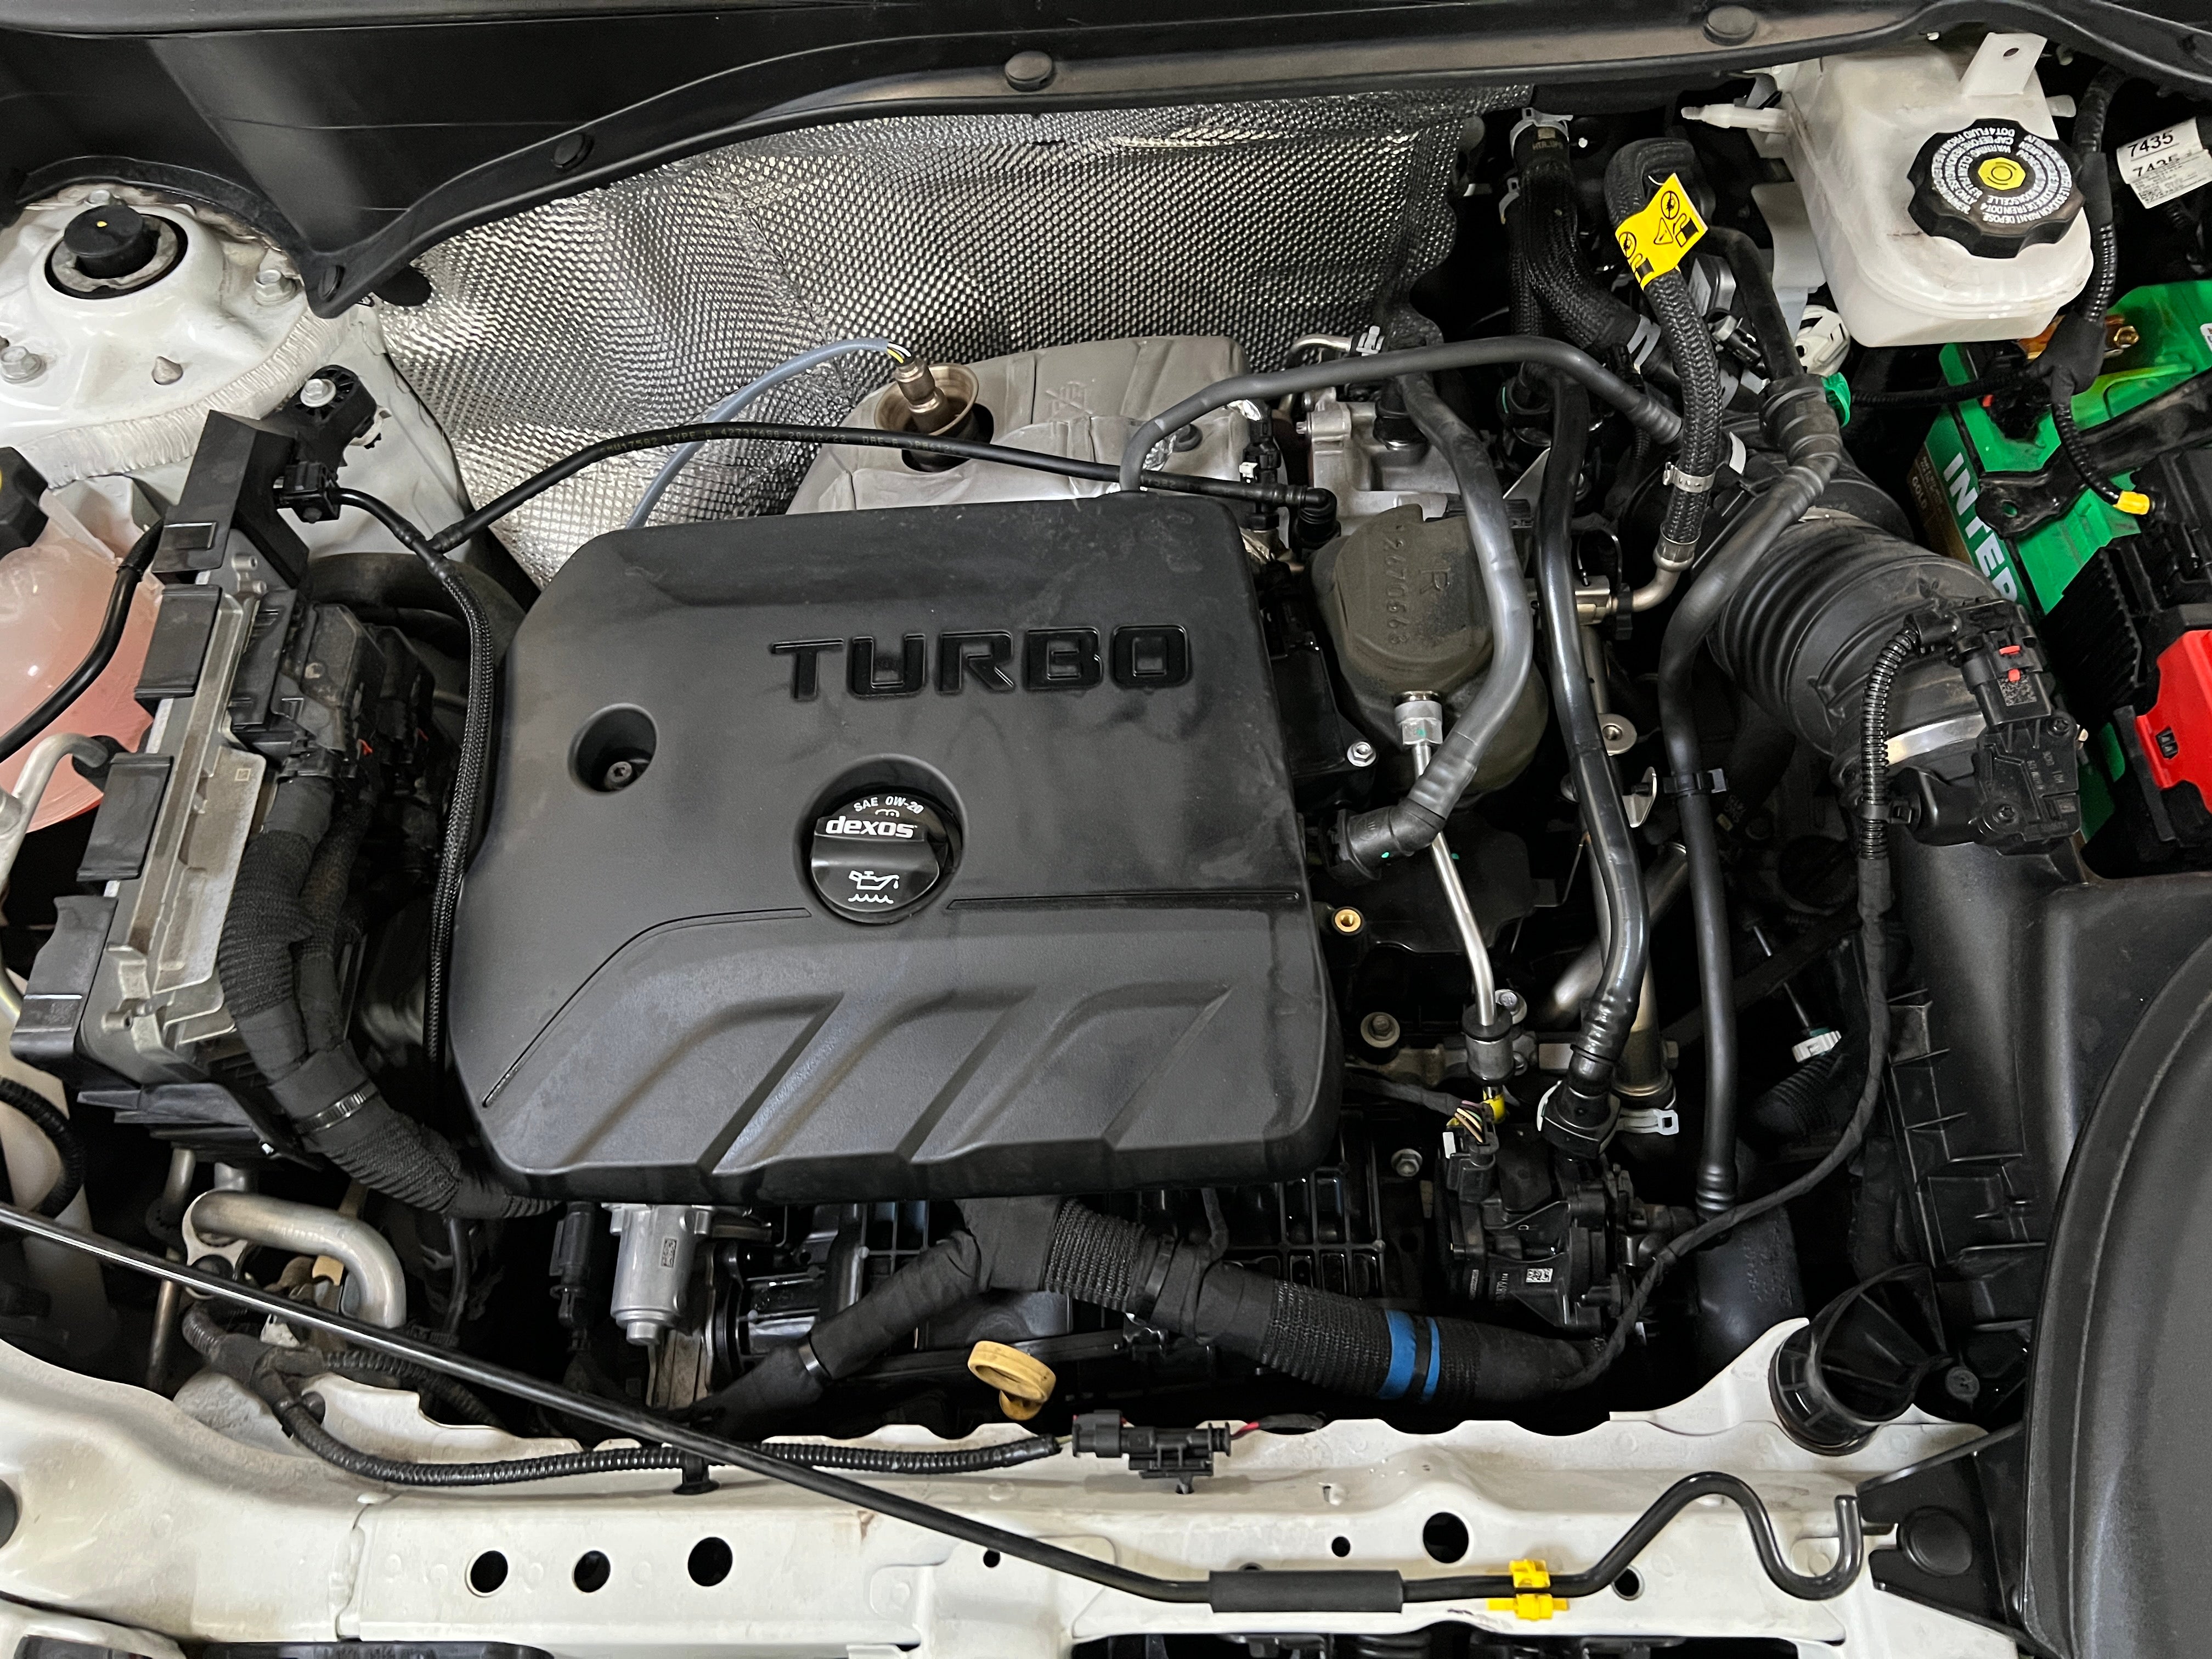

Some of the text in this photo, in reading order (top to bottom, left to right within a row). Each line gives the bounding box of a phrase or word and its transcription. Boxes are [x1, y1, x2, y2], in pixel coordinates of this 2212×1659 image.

[1994, 136, 2013, 144] CAP
[1995, 128, 2015, 137] DOT
[2128, 130, 2175, 157] 7435
[1985, 205, 2002, 214] DOT
[1911, 476, 1927, 509] GOLD
[1419, 567, 1453, 595] R
[770, 624, 1192, 700] TURBO
[854, 796, 924, 814] SAE 0W-20
[825, 816, 916, 839] dexos
